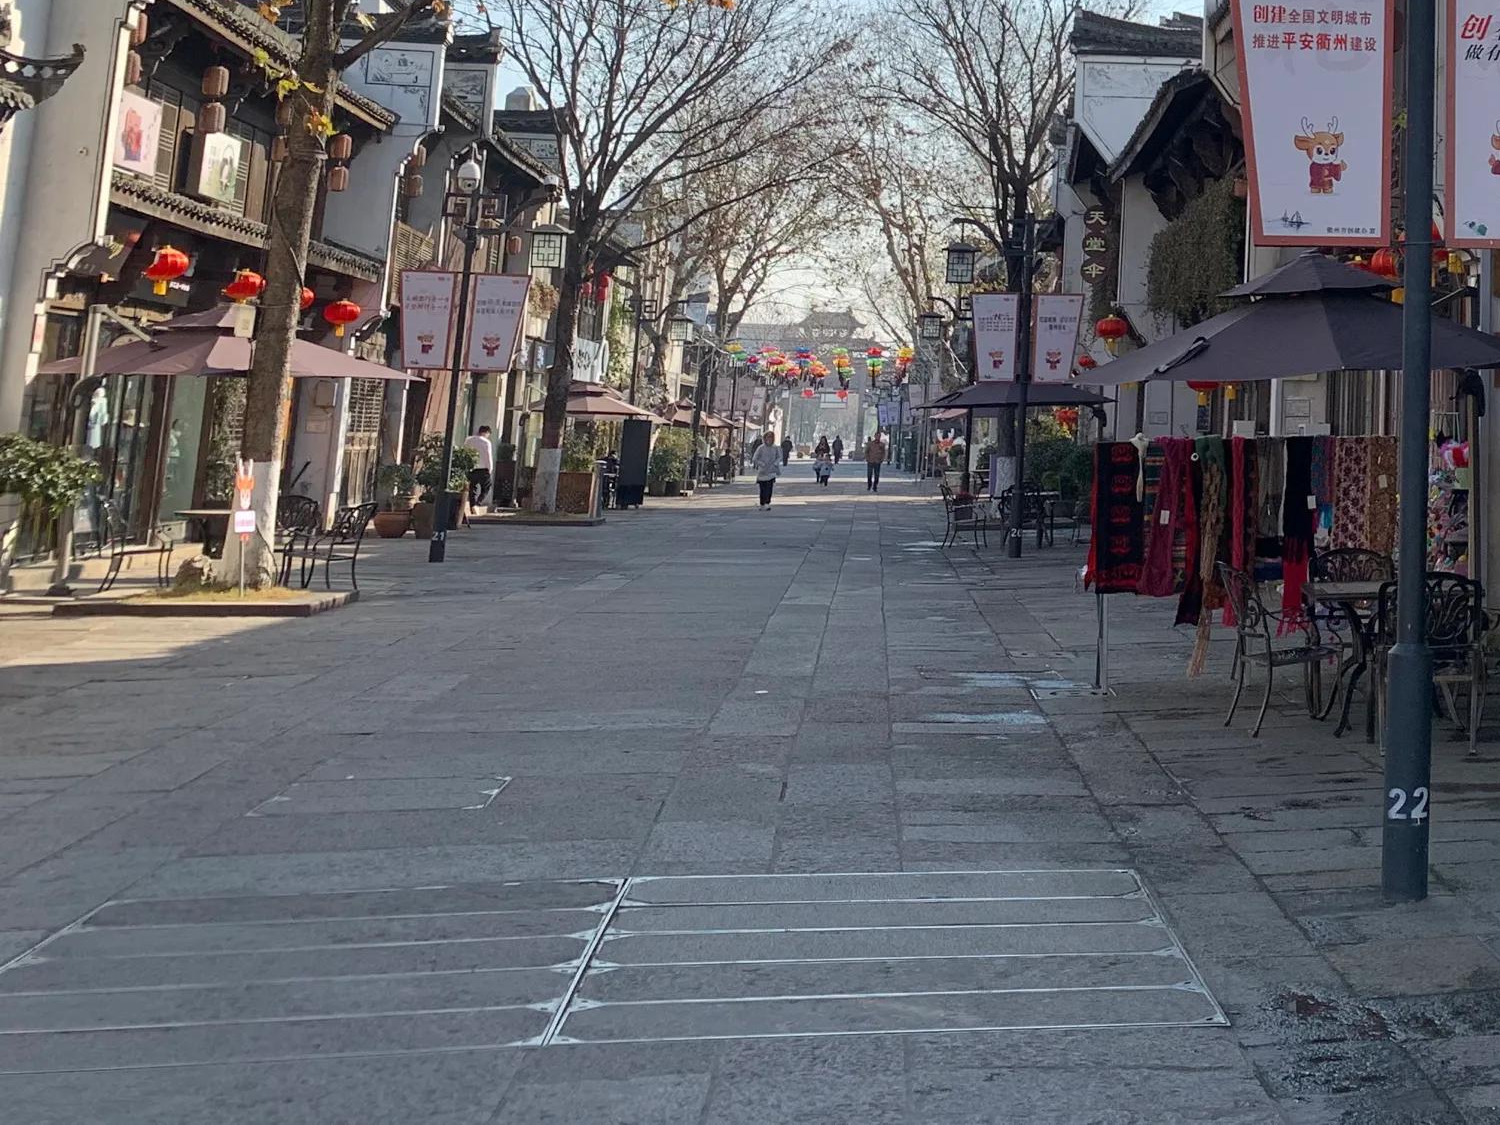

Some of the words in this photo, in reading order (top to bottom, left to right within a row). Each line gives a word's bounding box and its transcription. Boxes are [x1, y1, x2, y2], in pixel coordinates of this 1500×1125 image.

[1252, 4, 1372, 26] 创建全国文明城市
[1252, 32, 1377, 52] 推进平安衢州建设
[1082, 211, 1108, 278] 天堂伞
[431, 530, 446, 542] 21
[1387, 786, 1429, 820] 22
